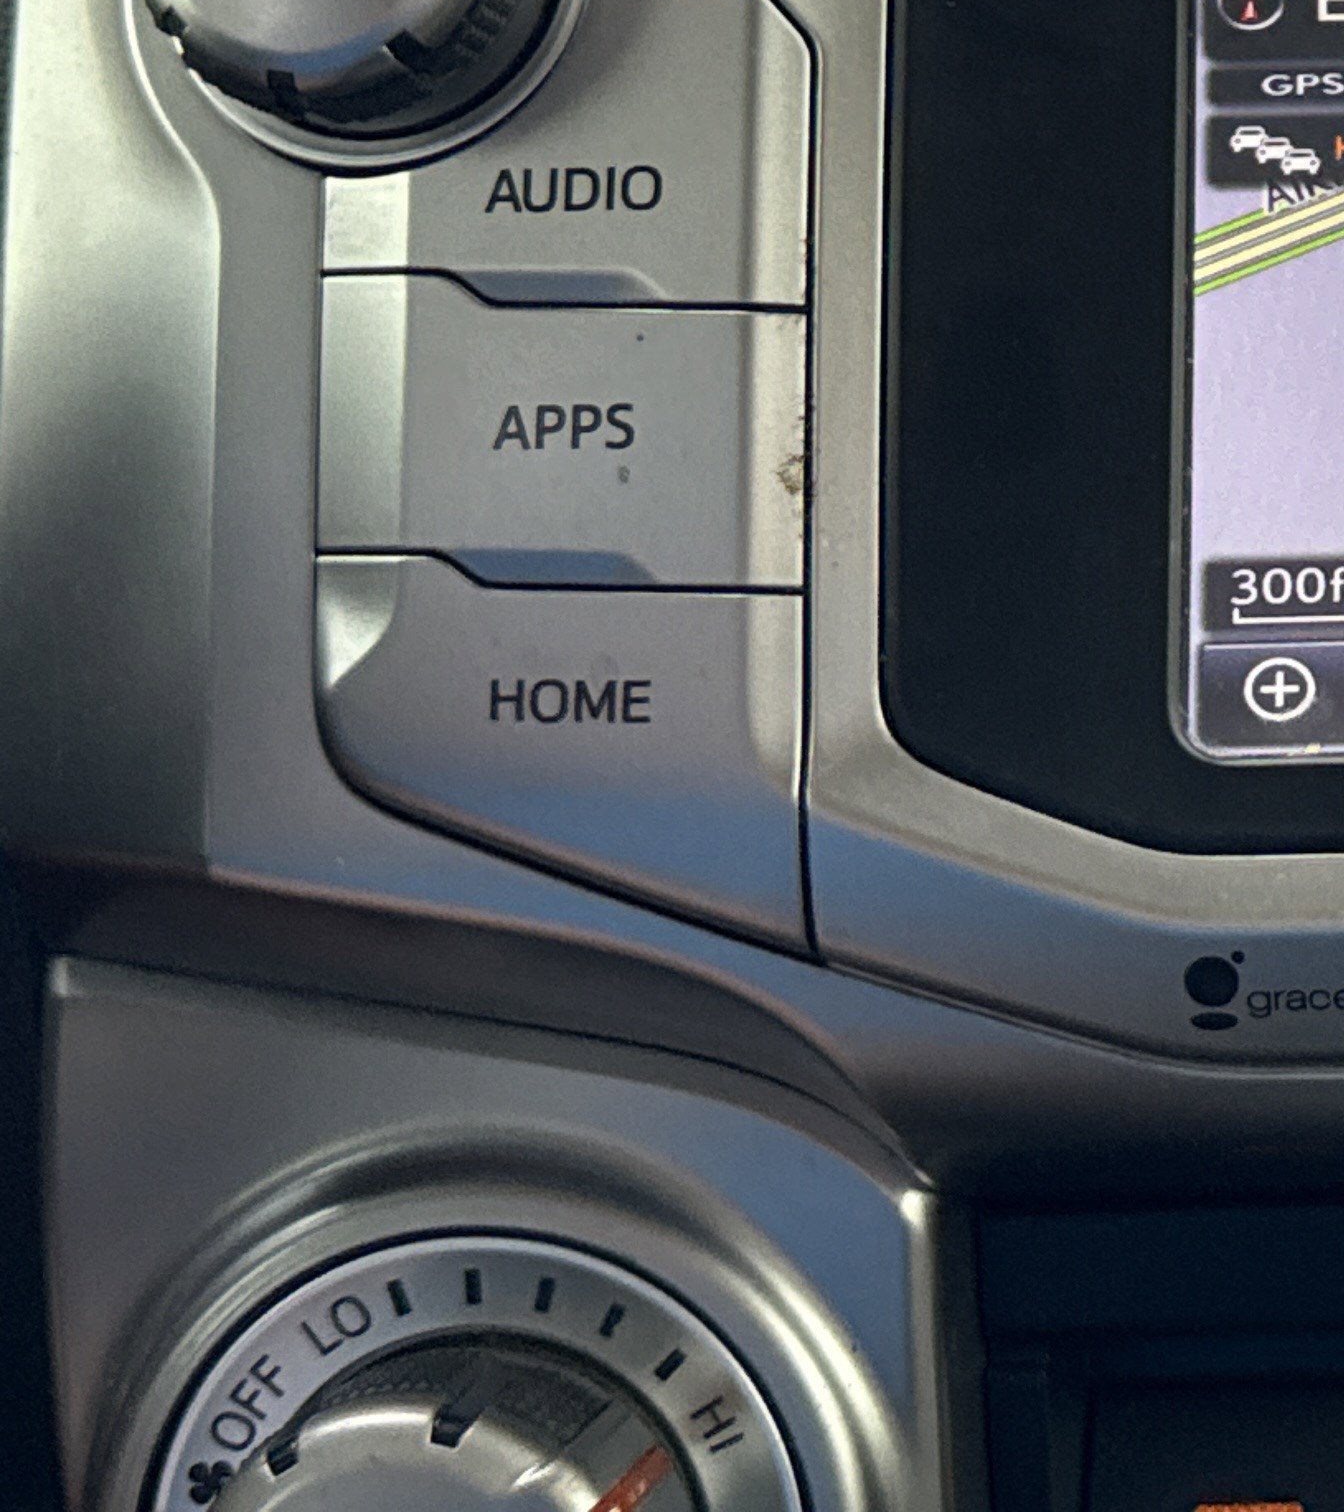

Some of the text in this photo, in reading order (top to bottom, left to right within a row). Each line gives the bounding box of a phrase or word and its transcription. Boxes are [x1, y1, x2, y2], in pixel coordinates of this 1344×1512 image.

[485, 166, 663, 213] AUDIO
[493, 404, 635, 450] APPS
[488, 678, 651, 724] HOME
[300, 1295, 372, 1356] LO
[211, 1355, 285, 1452] OFF
[689, 1394, 744, 1454] HI
